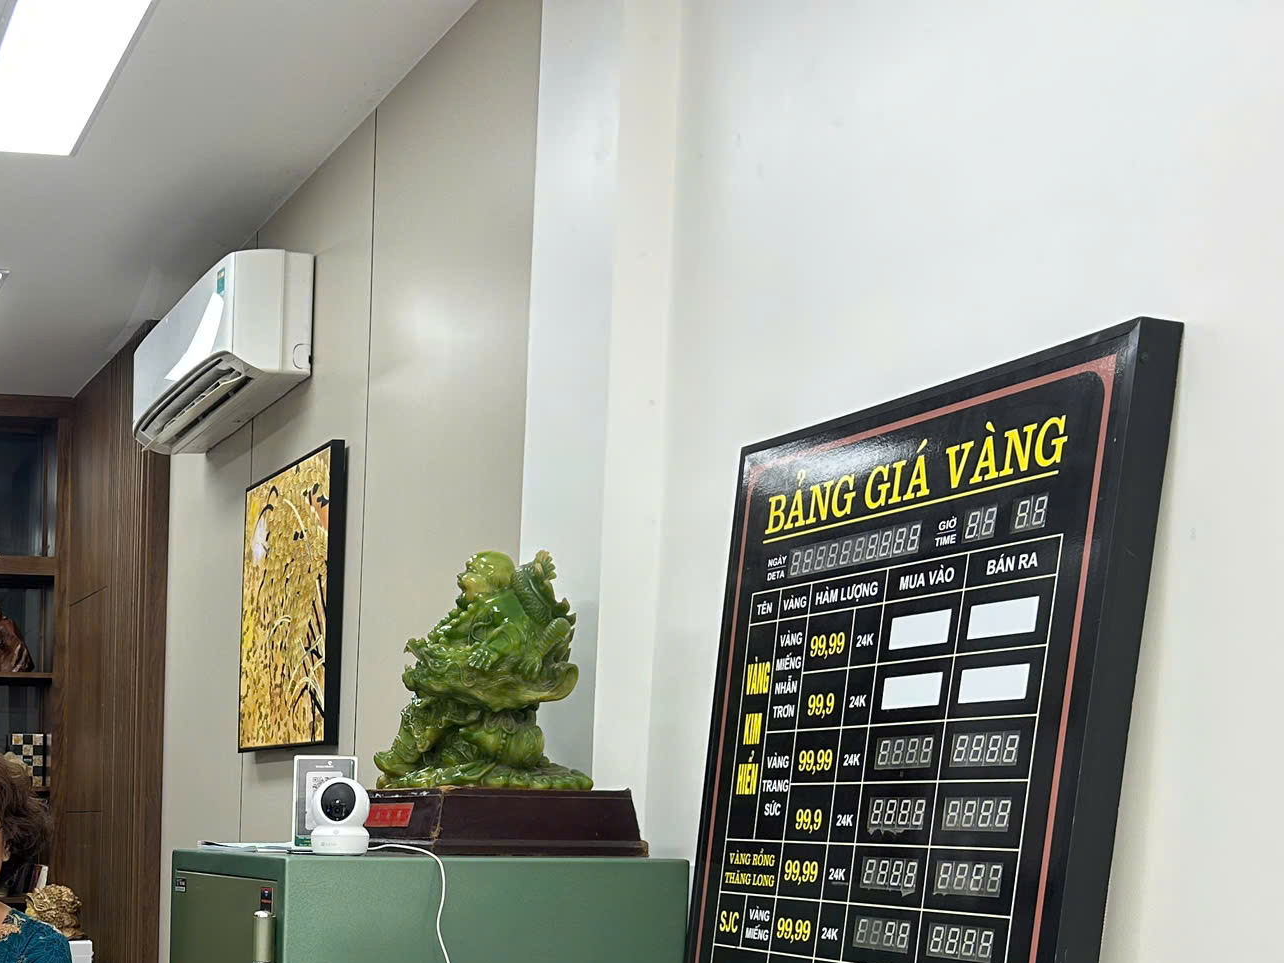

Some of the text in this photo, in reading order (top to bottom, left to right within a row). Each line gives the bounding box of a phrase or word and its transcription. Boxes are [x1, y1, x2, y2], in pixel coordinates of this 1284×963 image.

[765, 415, 1069, 535] BẢNG GIÁ VÀNG
[938, 516, 957, 531] GIỜ
[935, 533, 957, 547] TIME
[767, 555, 787, 568] NGÀY
[986, 552, 1038, 575] BÁN RA
[767, 570, 785, 582] DETA
[899, 564, 955, 591] MUA VÀO
[815, 581, 879, 605] HÀM LƯỢNG
[757, 601, 773, 615] TÊN
[783, 593, 807, 611] VÀNG
[780, 630, 803, 647] VÀNG
[810, 632, 845, 659] 99,99
[856, 633, 874, 648] 24K
[807, 693, 835, 719] 99,9
[849, 695, 867, 709] 24K
[743, 713, 763, 745] KIM
[767, 752, 790, 768] VÀNG
[798, 749, 833, 775] 99,99
[843, 753, 861, 767] 24K
[762, 780, 789, 793] TRANG
[764, 800, 781, 816] SỨC
[795, 809, 822, 834] 99,9
[836, 814, 854, 827] 24K
[729, 850, 751, 865] VÀNG
[752, 874, 775, 887] LONG
[784, 860, 819, 885] 99,99
[828, 868, 846, 882] 24K
[749, 905, 770, 922] VÀNG
[719, 911, 739, 933] SJC
[776, 917, 811, 943] 99,99
[821, 927, 839, 941] 24K
